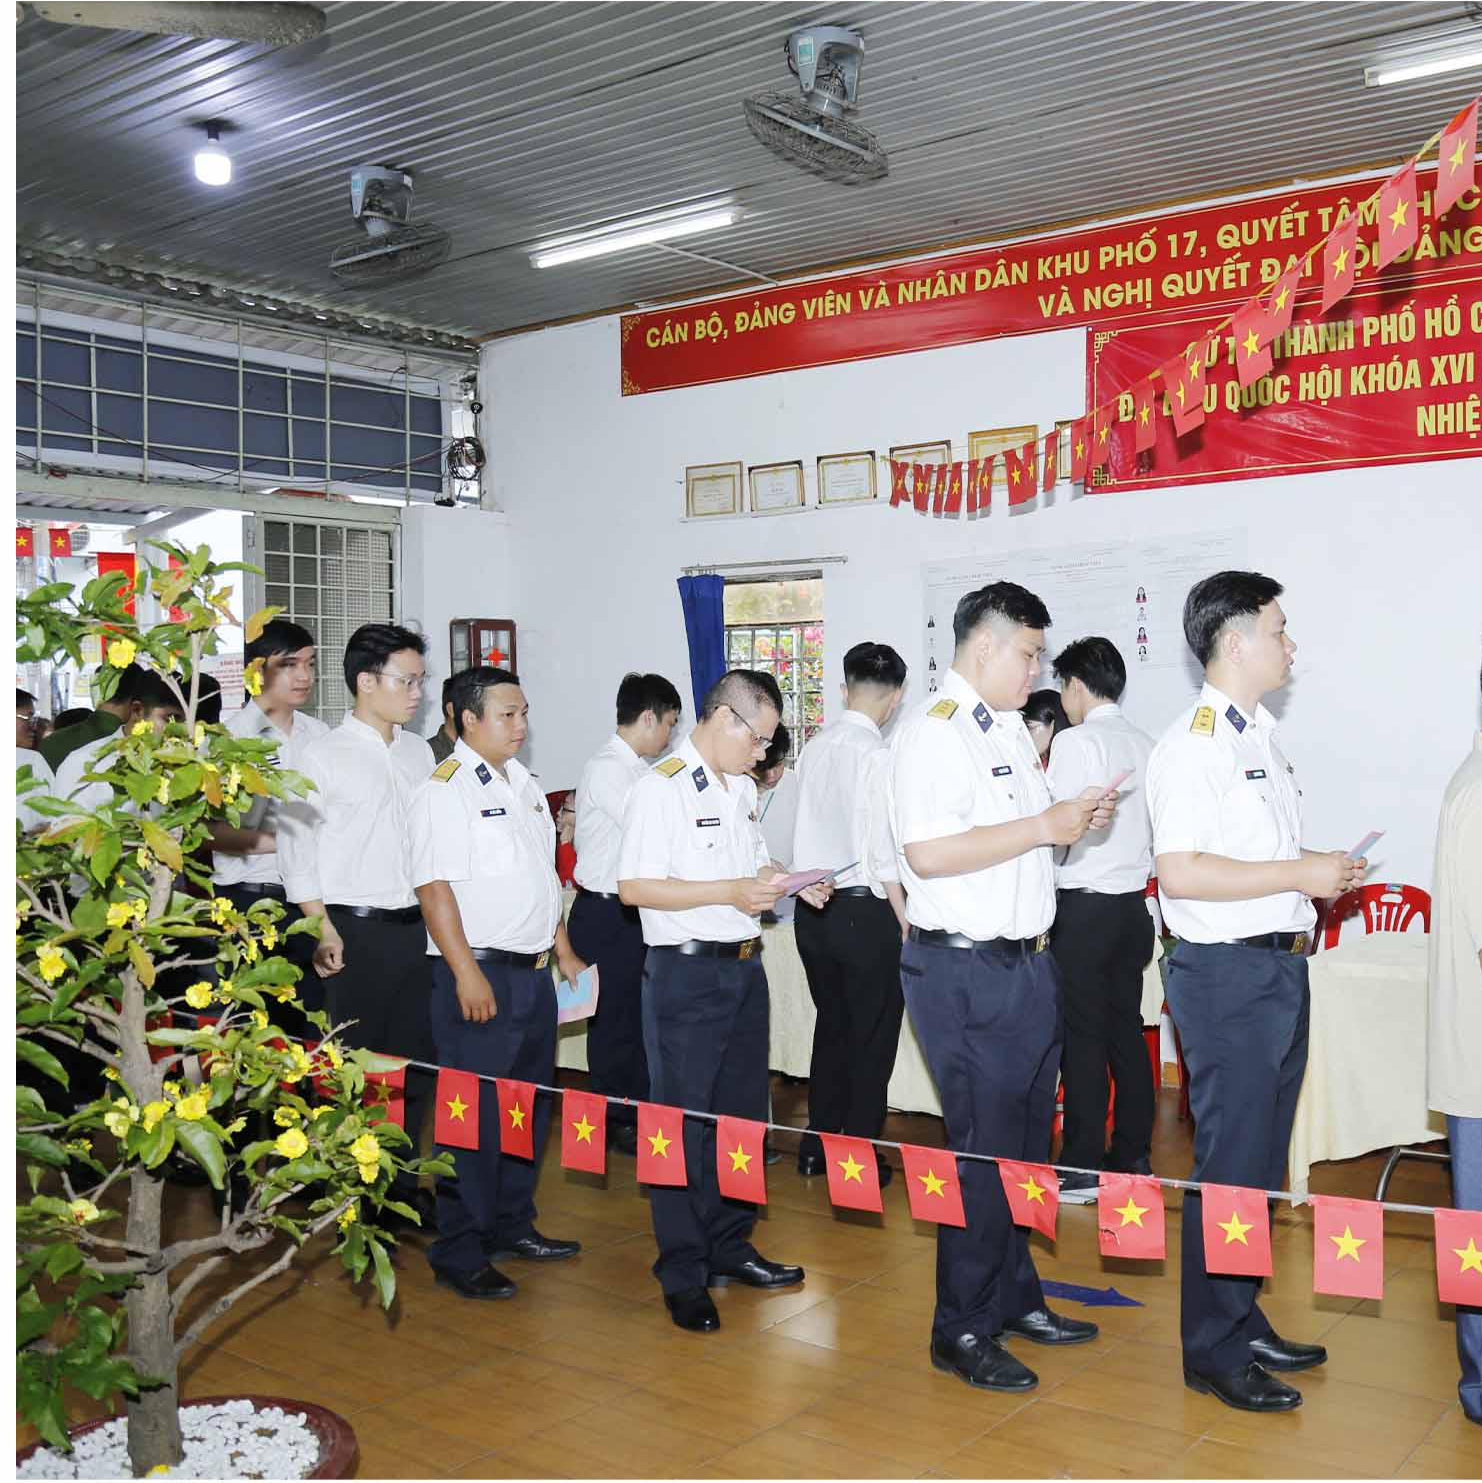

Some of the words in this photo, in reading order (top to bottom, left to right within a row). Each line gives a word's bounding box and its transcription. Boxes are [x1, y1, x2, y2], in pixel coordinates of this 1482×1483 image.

[646, 318, 688, 350] CÁN
[694, 315, 729, 349] BỘ,
[734, 300, 796, 335] ĐẢNG
[802, 291, 851, 321] VIÊN
[858, 278, 892, 311] VÀ
[897, 269, 968, 306] NHÂN
[974, 257, 1029, 292] DÂN
[1036, 249, 1091, 281] KHU
[1100, 227, 1157, 274] PHỐ
[1166, 230, 1207, 263] 17,
[1216, 200, 1310, 251] QUYẾT
